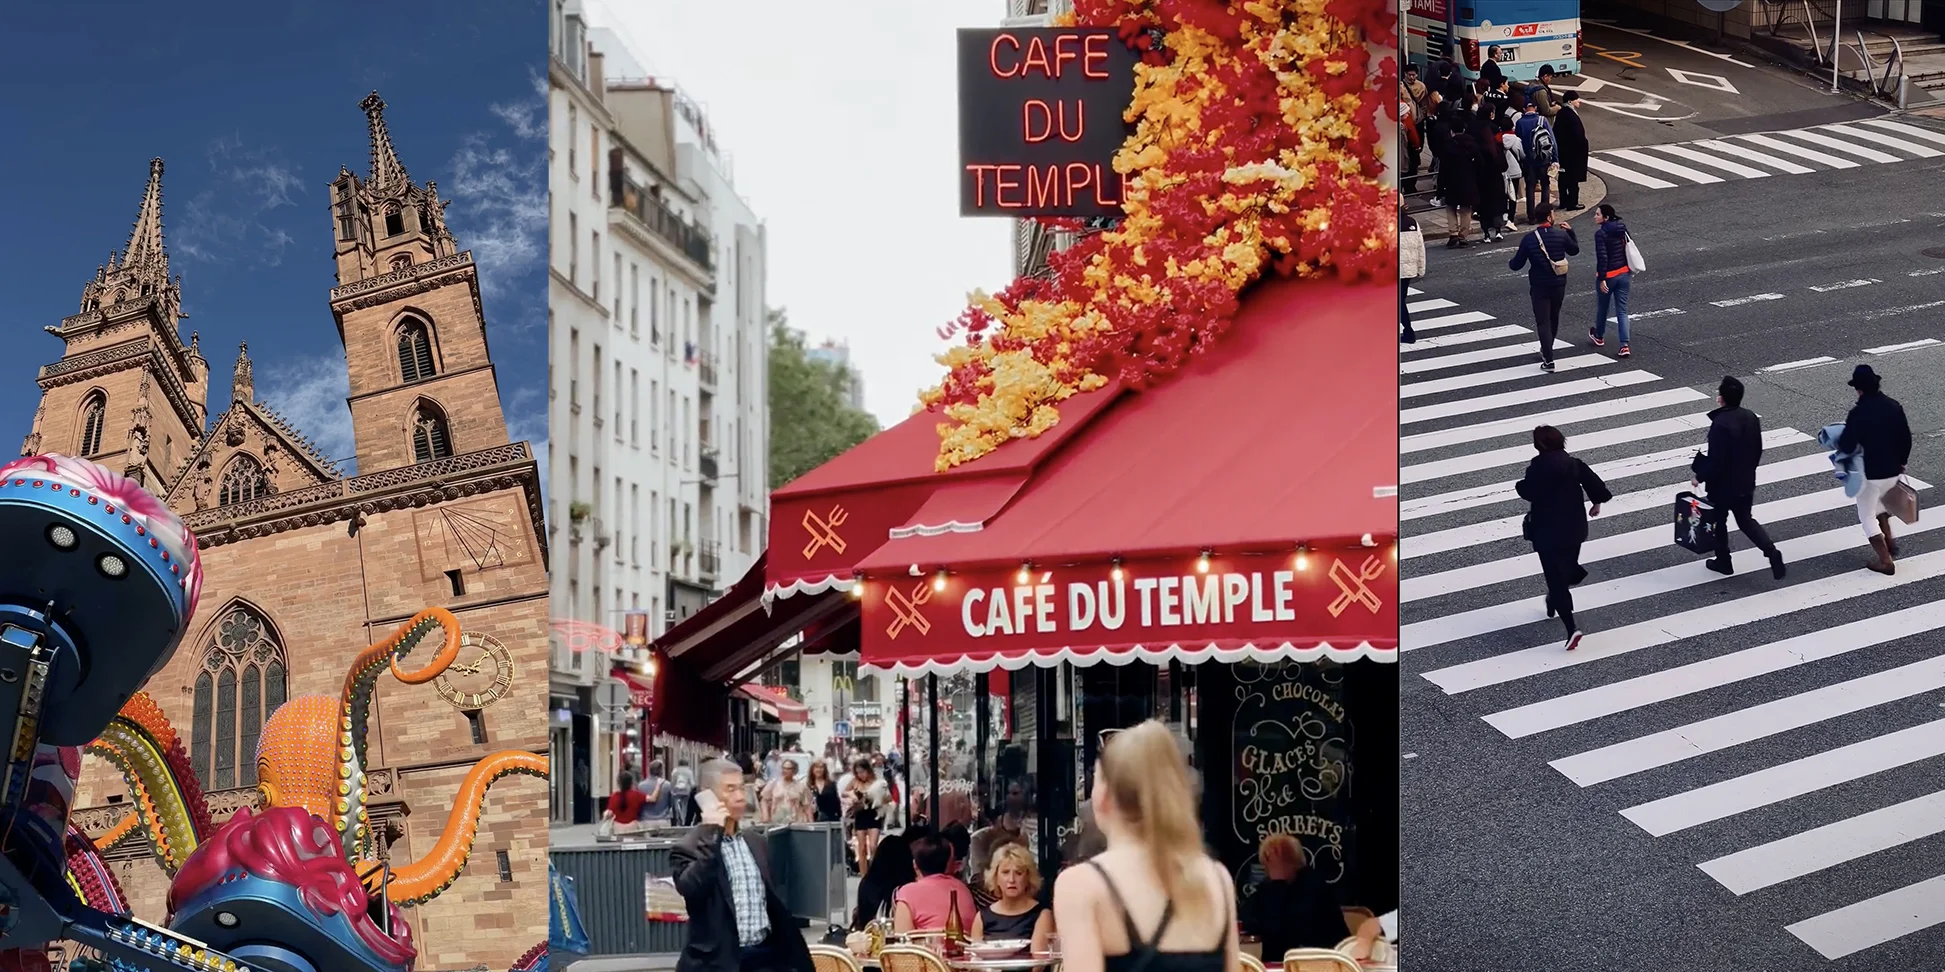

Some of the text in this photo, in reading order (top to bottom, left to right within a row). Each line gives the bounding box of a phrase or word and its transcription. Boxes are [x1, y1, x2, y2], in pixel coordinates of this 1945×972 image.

[990, 33, 1110, 78] CAFE
[1024, 99, 1084, 142] DU
[961, 570, 1296, 637] CAFÉ DU TEMPLE
[1241, 739, 1316, 776] GLACES
[1257, 815, 1343, 845] SORBETS
